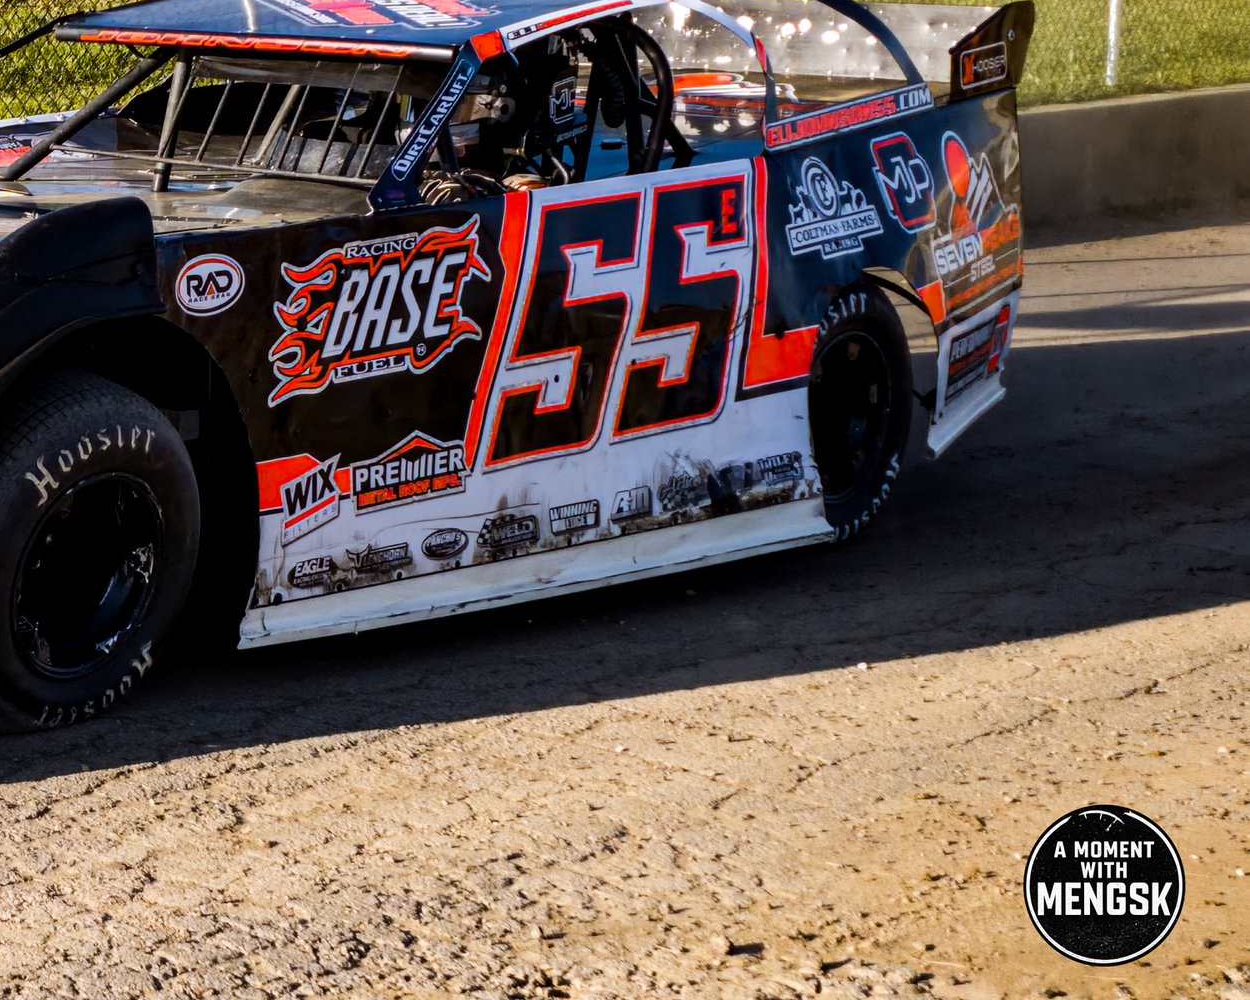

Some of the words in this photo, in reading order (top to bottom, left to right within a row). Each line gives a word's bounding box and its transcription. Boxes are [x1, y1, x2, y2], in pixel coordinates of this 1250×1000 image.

[394, 74, 468, 172] DIRTCARLIFT
[767, 88, 931, 147] ELIJOHNSON55.COM
[878, 156, 930, 203] MJP
[721, 189, 737, 234] E
[346, 238, 417, 258] RACING
[936, 232, 983, 275] SEVEN
[186, 270, 233, 297] RAD
[321, 252, 467, 359] BASE
[335, 355, 406, 379] FUEL
[285, 462, 335, 516] WIX
[355, 449, 464, 492] PREMIER
[358, 487, 397, 506] METAL
[399, 479, 430, 497] ROOF
[550, 501, 597, 520] WINNING
[284, 505, 336, 539] FILTERS
[294, 556, 332, 577] EAGLE
